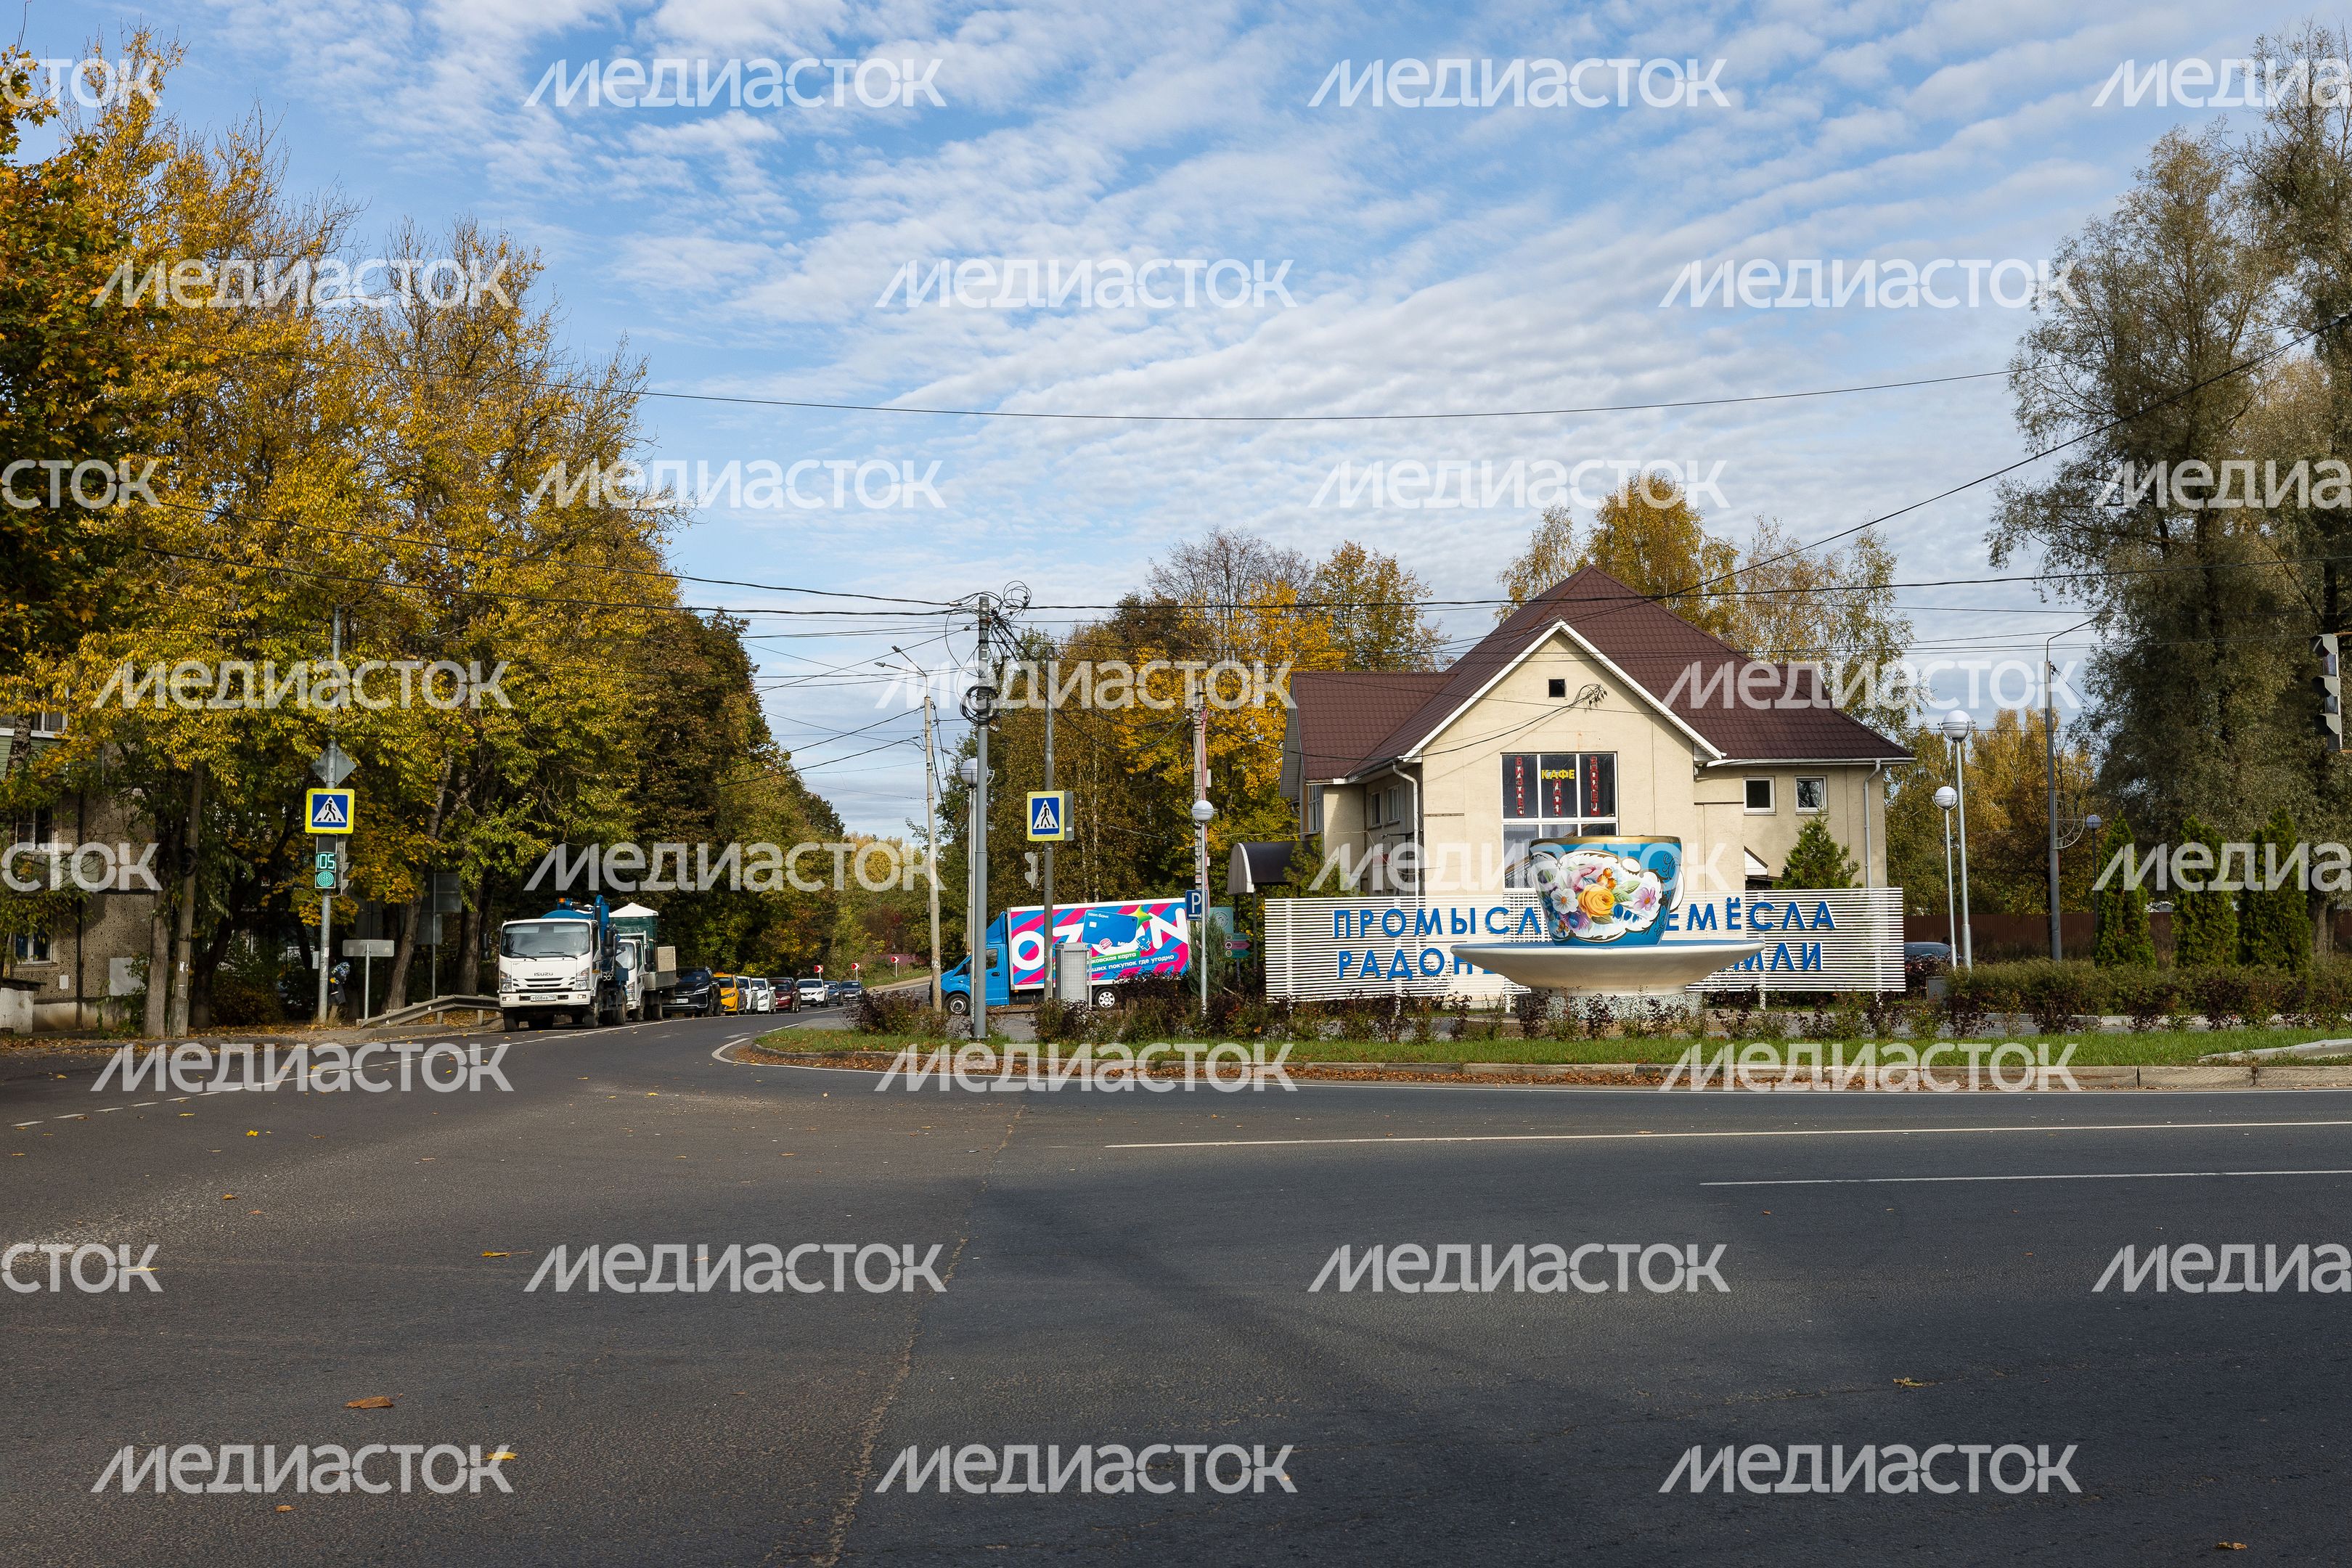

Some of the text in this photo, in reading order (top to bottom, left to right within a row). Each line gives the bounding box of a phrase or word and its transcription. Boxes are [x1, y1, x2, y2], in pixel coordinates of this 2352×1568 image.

[1541, 769, 1575, 780] КАФЕ
[317, 854, 335, 869] 105
[1665, 897, 1837, 931] ЕМЁСЛА
[1108, 960, 1138, 970] покупок
[1151, 955, 1175, 964] угодно
